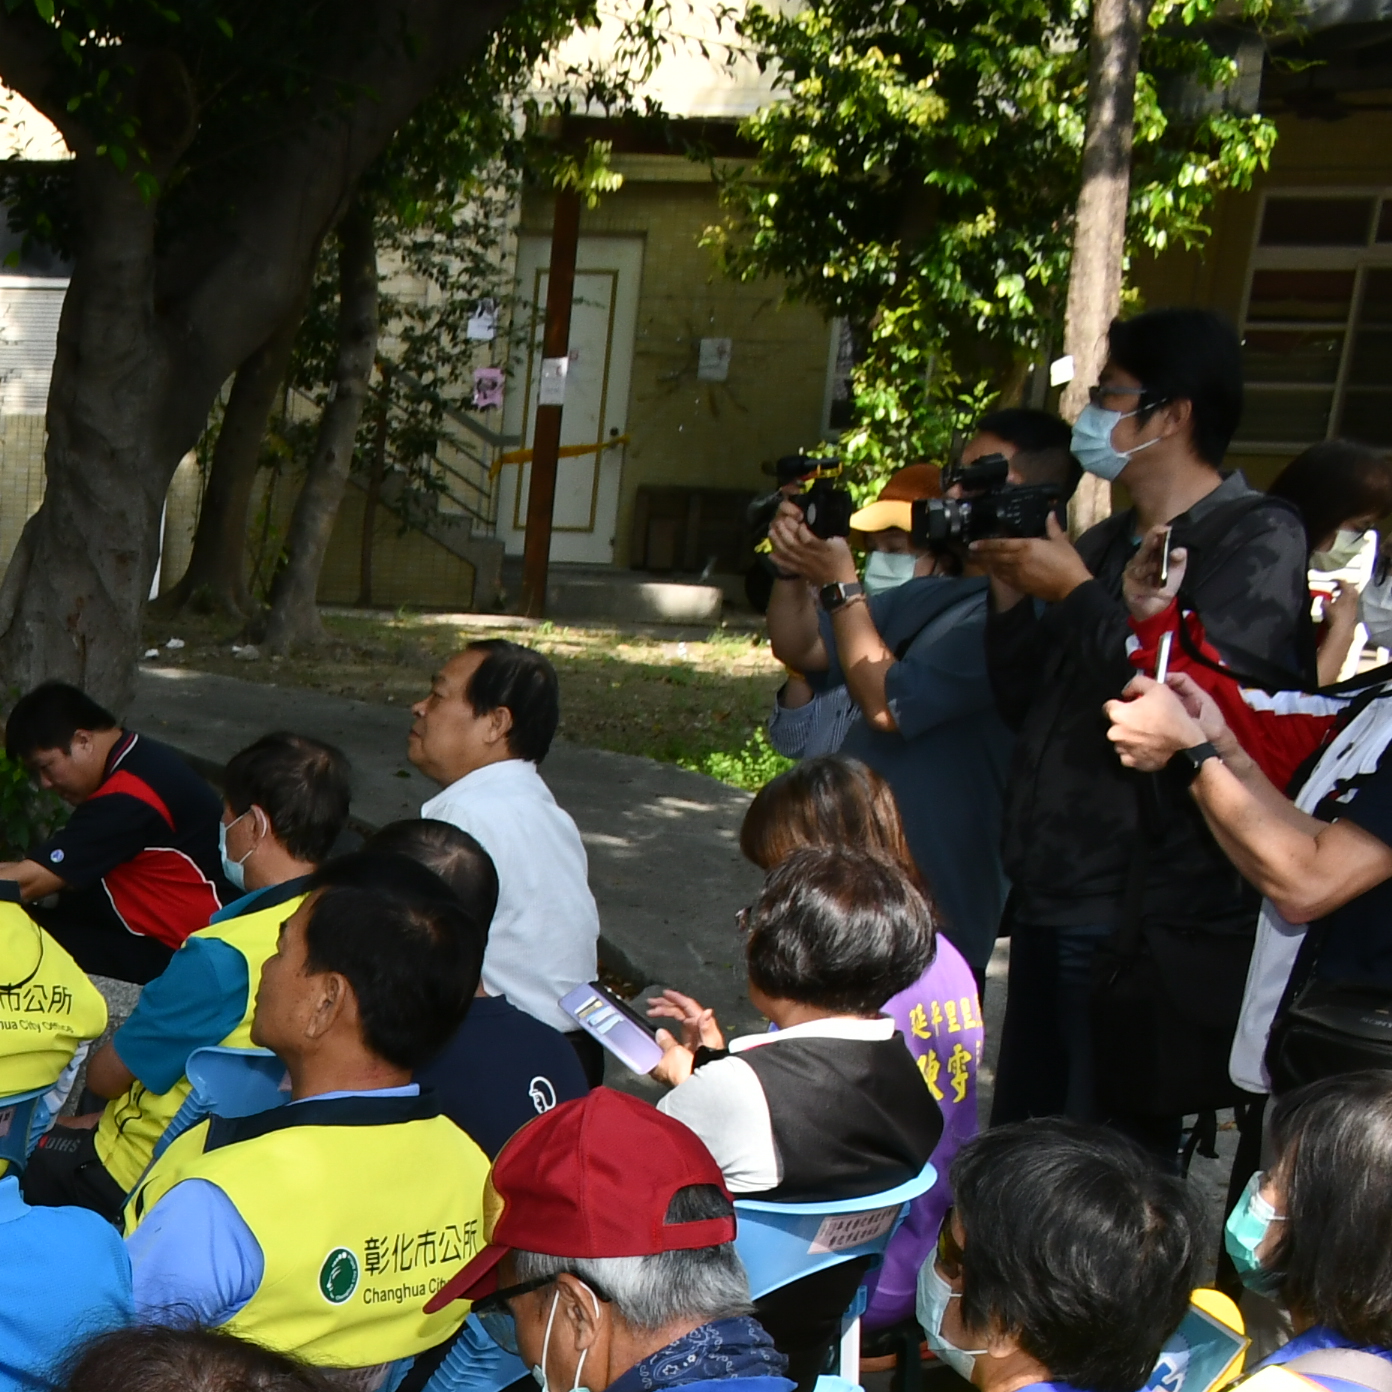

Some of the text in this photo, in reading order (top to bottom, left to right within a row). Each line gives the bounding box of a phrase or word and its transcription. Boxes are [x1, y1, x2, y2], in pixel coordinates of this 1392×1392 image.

[19, 1020, 42, 1033] City
[364, 1219, 478, 1277] 彰化市公所
[363, 1283, 426, 1304] Changhua
